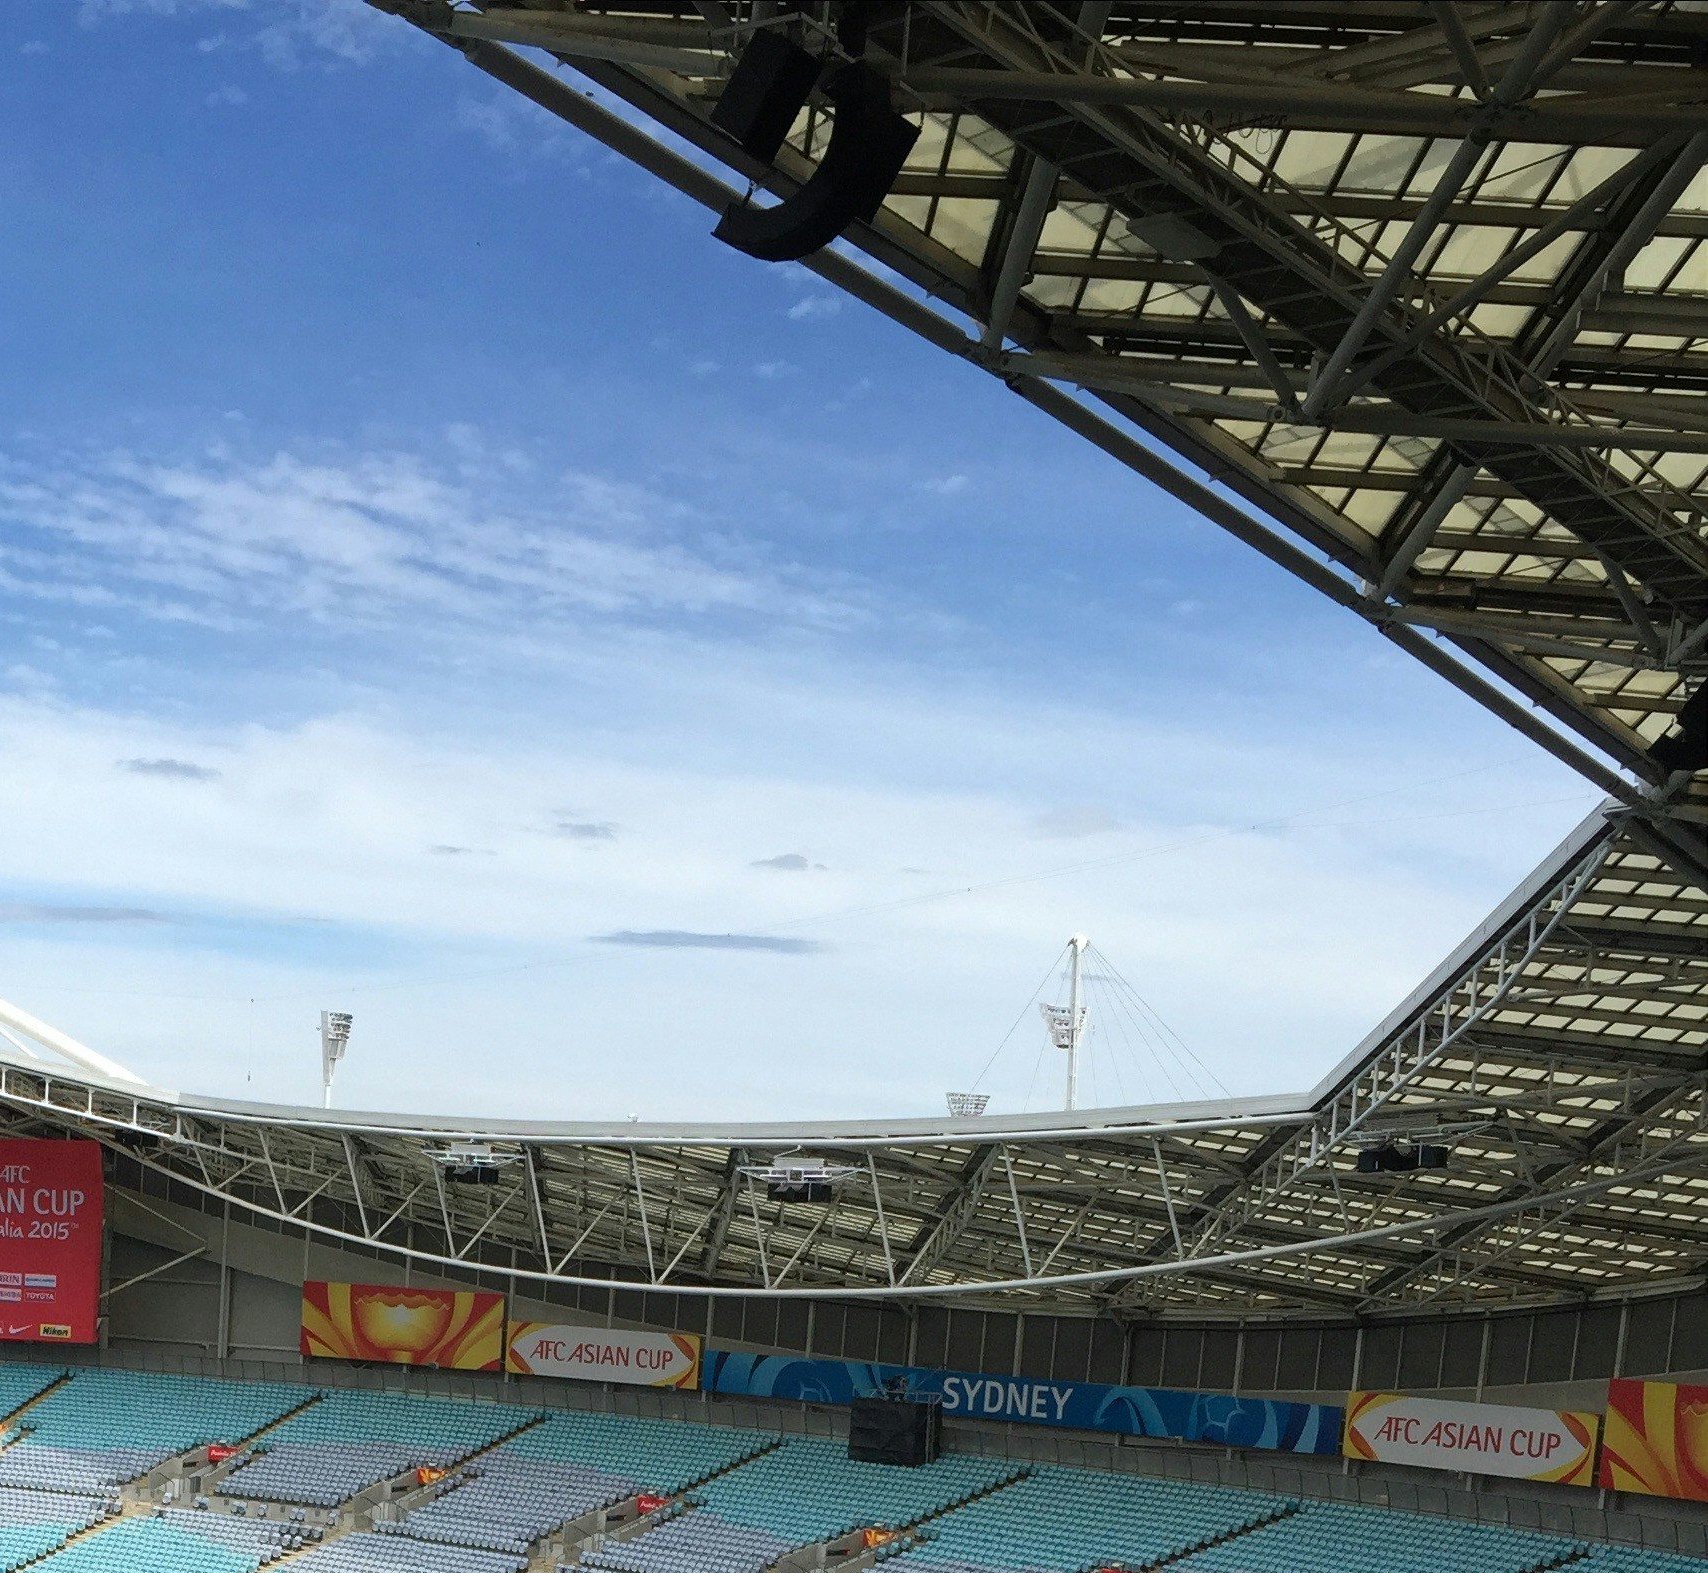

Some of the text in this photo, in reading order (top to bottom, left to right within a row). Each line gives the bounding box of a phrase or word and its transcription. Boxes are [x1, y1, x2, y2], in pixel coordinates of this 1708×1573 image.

[33, 1189, 85, 1216] CUP
[28, 1221, 70, 1240] 2015
[530, 1338, 674, 1371] AFC ASIAN CUP
[941, 1377, 1073, 1421] SYDNEY
[1374, 1416, 1562, 1460] AFC ASIAN CUP
